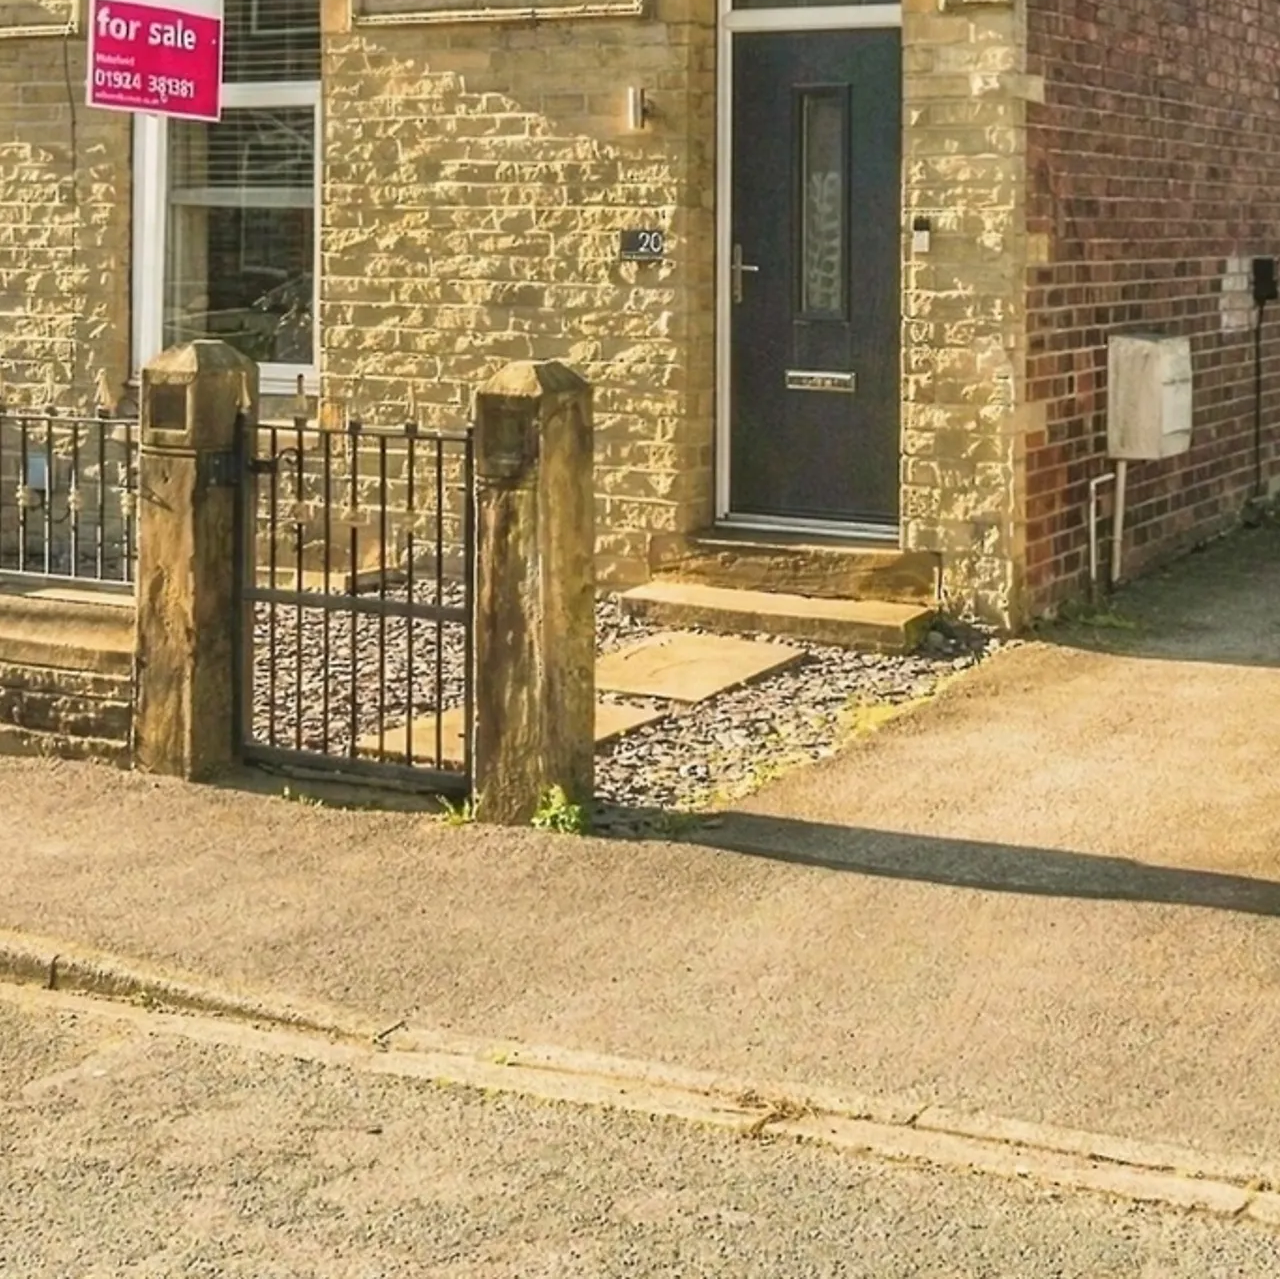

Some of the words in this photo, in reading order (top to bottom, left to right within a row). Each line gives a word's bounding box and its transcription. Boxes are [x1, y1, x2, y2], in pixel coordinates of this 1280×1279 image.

[97, 7, 141, 41] for
[148, 19, 197, 51] sale
[95, 68, 142, 90] 01924
[639, 232, 662, 252] 20
